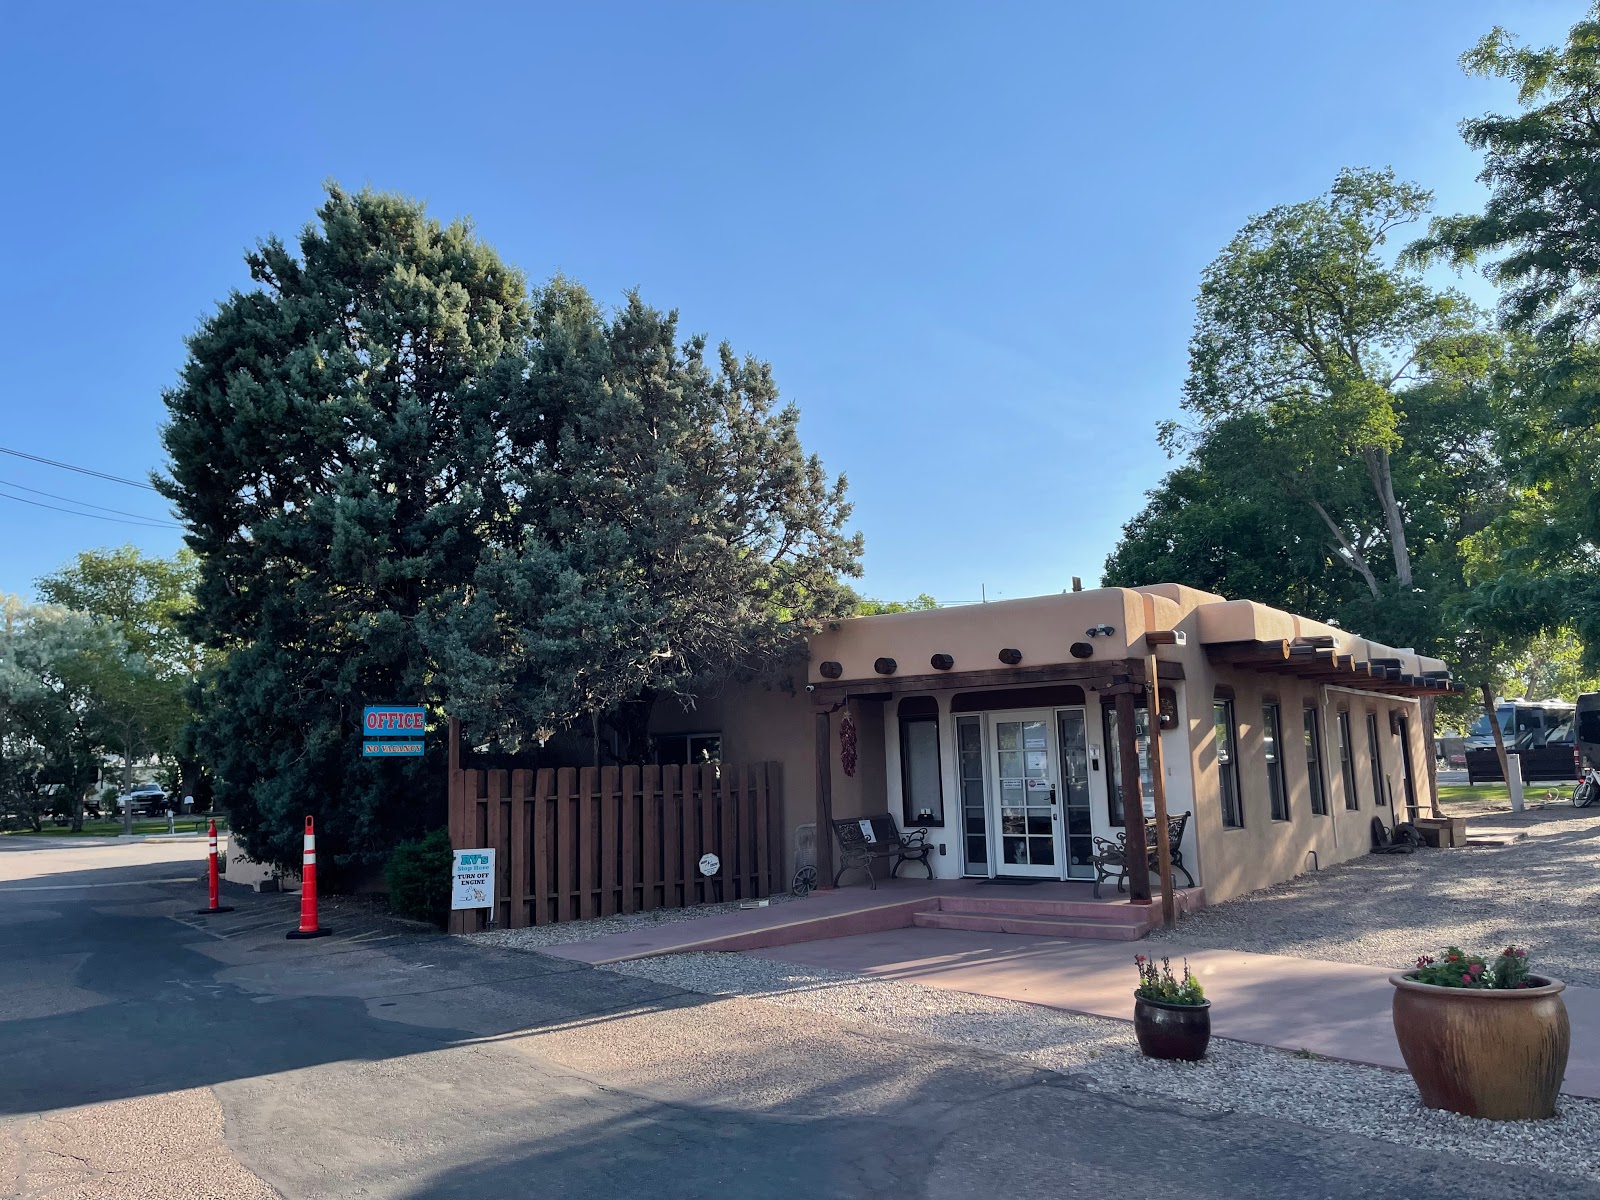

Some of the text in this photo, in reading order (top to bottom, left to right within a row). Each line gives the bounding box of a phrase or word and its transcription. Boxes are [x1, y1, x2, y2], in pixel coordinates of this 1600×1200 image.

[367, 712, 424, 729] OFFICE
[366, 745, 422, 753] NO VACANCY
